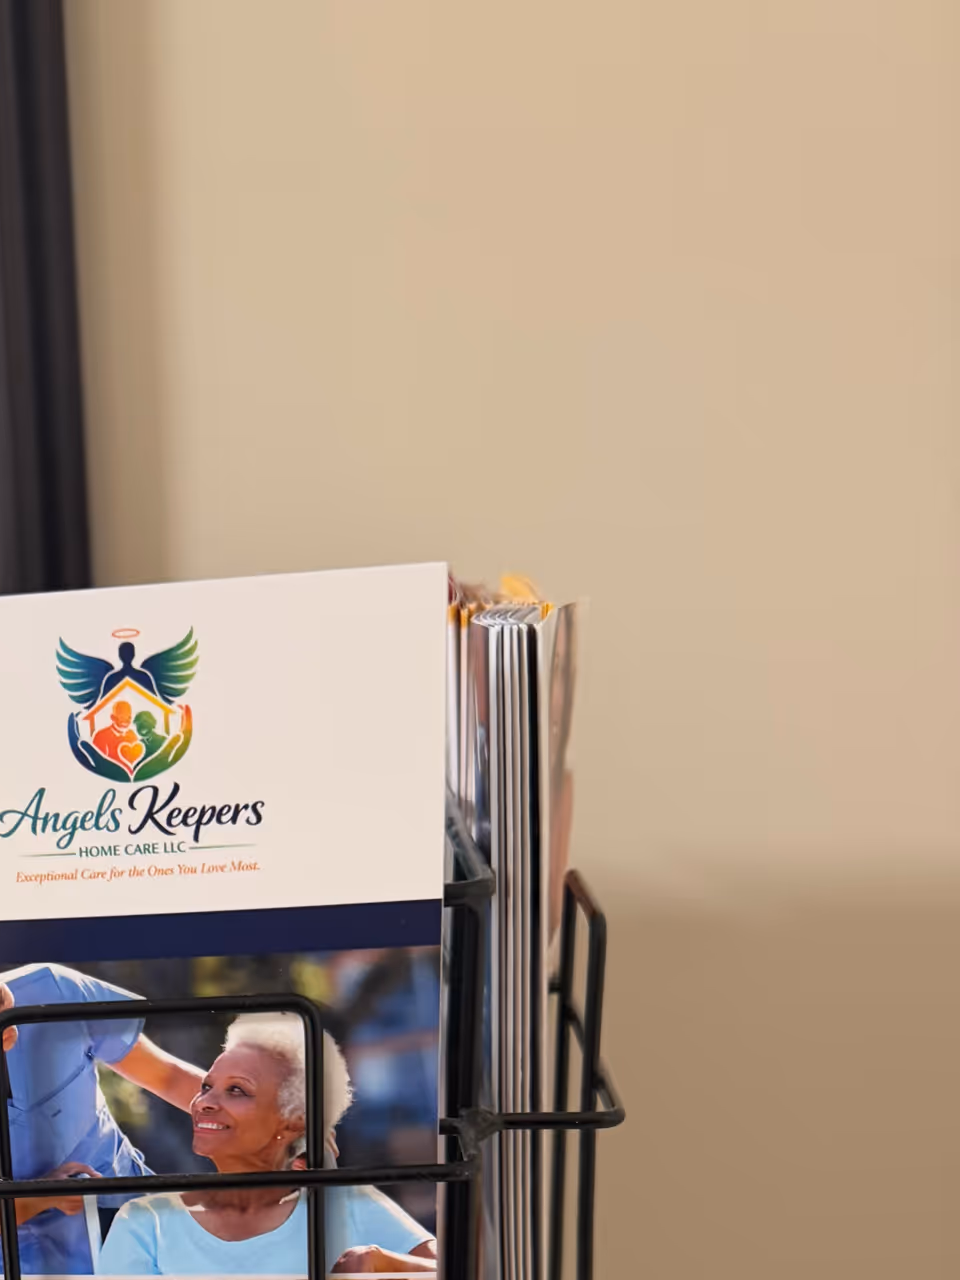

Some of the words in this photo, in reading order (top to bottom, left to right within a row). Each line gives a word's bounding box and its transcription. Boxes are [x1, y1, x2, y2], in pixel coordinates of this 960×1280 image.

[127, 781, 265, 843] Keepers
[78, 845, 121, 858] HOME
[124, 843, 159, 856] CARE
[162, 841, 187, 854] LLC
[15, 867, 78, 885] Exceptional
[81, 867, 106, 880] Care
[106, 865, 126, 883] for
[128, 865, 145, 878] the
[147, 865, 175, 877] Ones
[177, 862, 198, 875] You
[201, 861, 228, 874] Love
[231, 859, 261, 873] Most.
